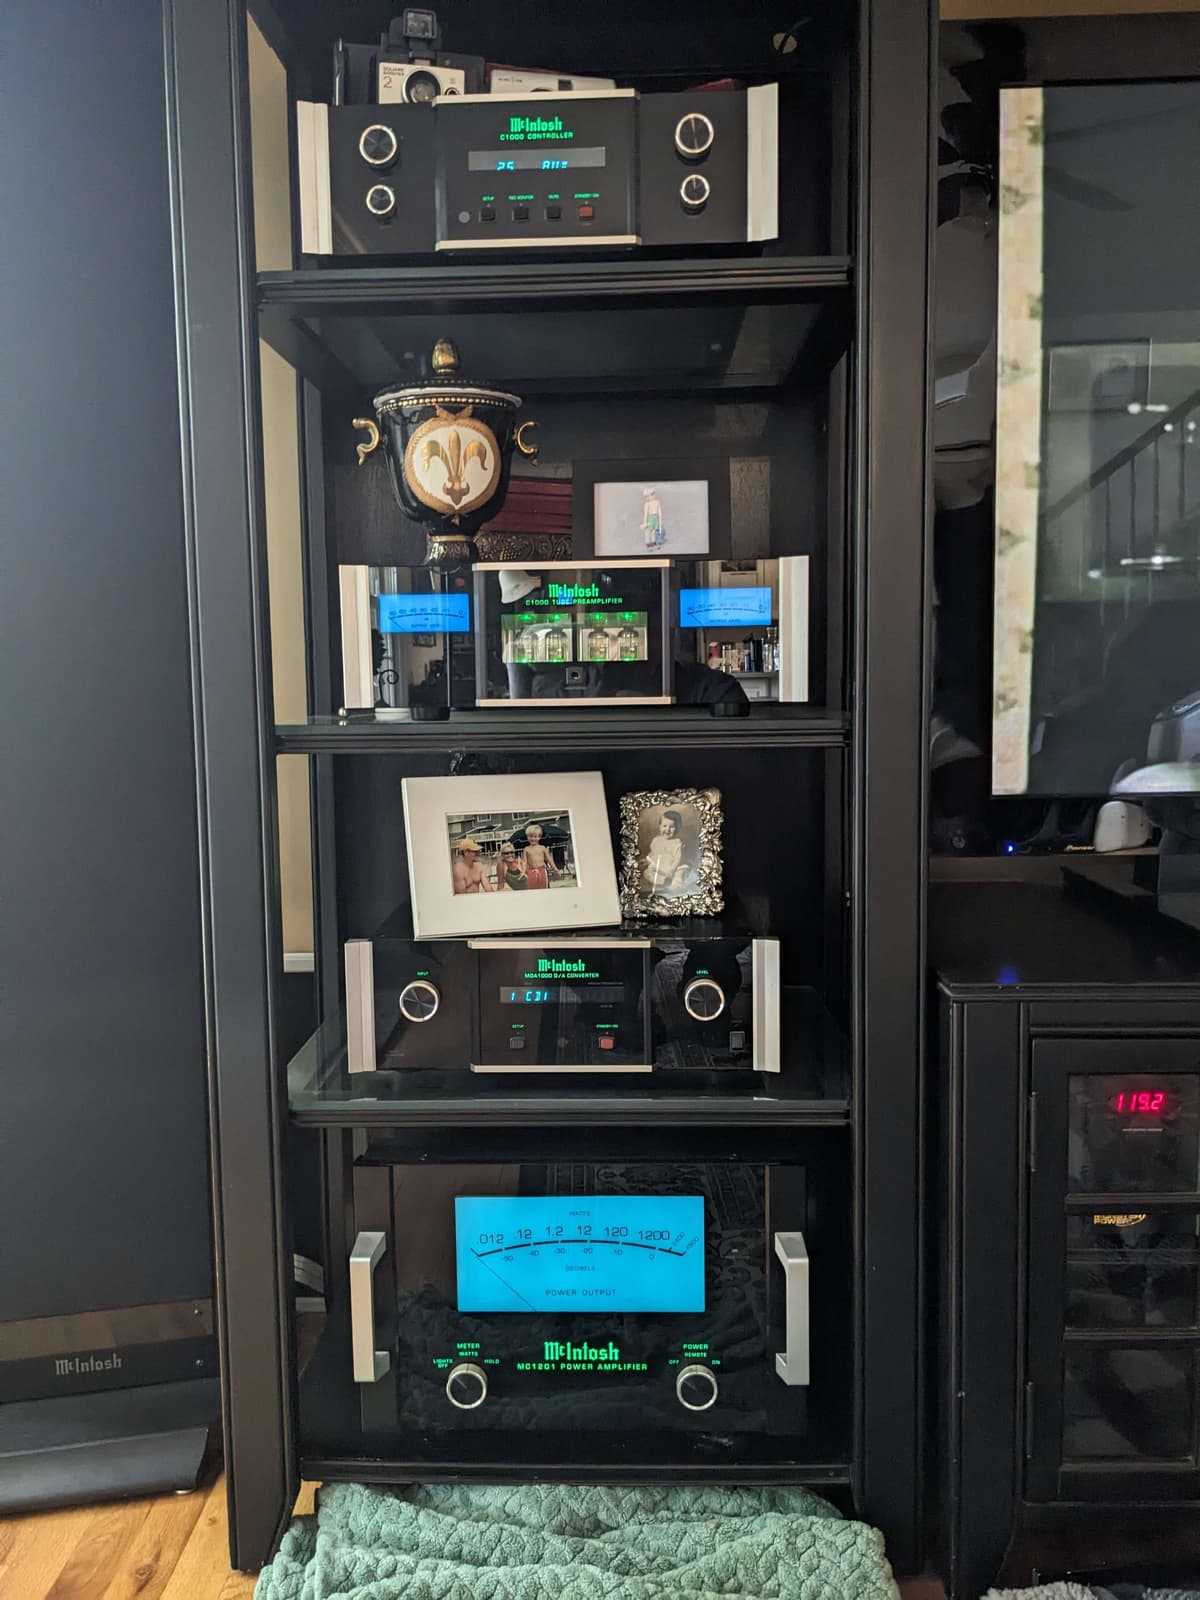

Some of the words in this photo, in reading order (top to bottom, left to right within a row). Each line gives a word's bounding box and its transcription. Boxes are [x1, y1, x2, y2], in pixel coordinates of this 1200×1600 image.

[383, 76, 392, 88] 2
[510, 116, 563, 132] McIntosh
[548, 583, 599, 598] McIntosh
[538, 959, 586, 972] McIntosh
[545, 1225, 564, 1237] 1.2
[576, 1224, 593, 1236] 12
[603, 1226, 629, 1238] 120
[637, 1230, 671, 1241] 1200
[545, 1288, 577, 1297] POWER
[582, 1288, 617, 1297] OUTPUT
[543, 1341, 619, 1361] McIntosh
[55, 1352, 122, 1375] McIntosh
[517, 1363, 556, 1371] MC1201
[560, 1363, 593, 1371] POWER
[597, 1363, 648, 1371] AMPLIFIER
